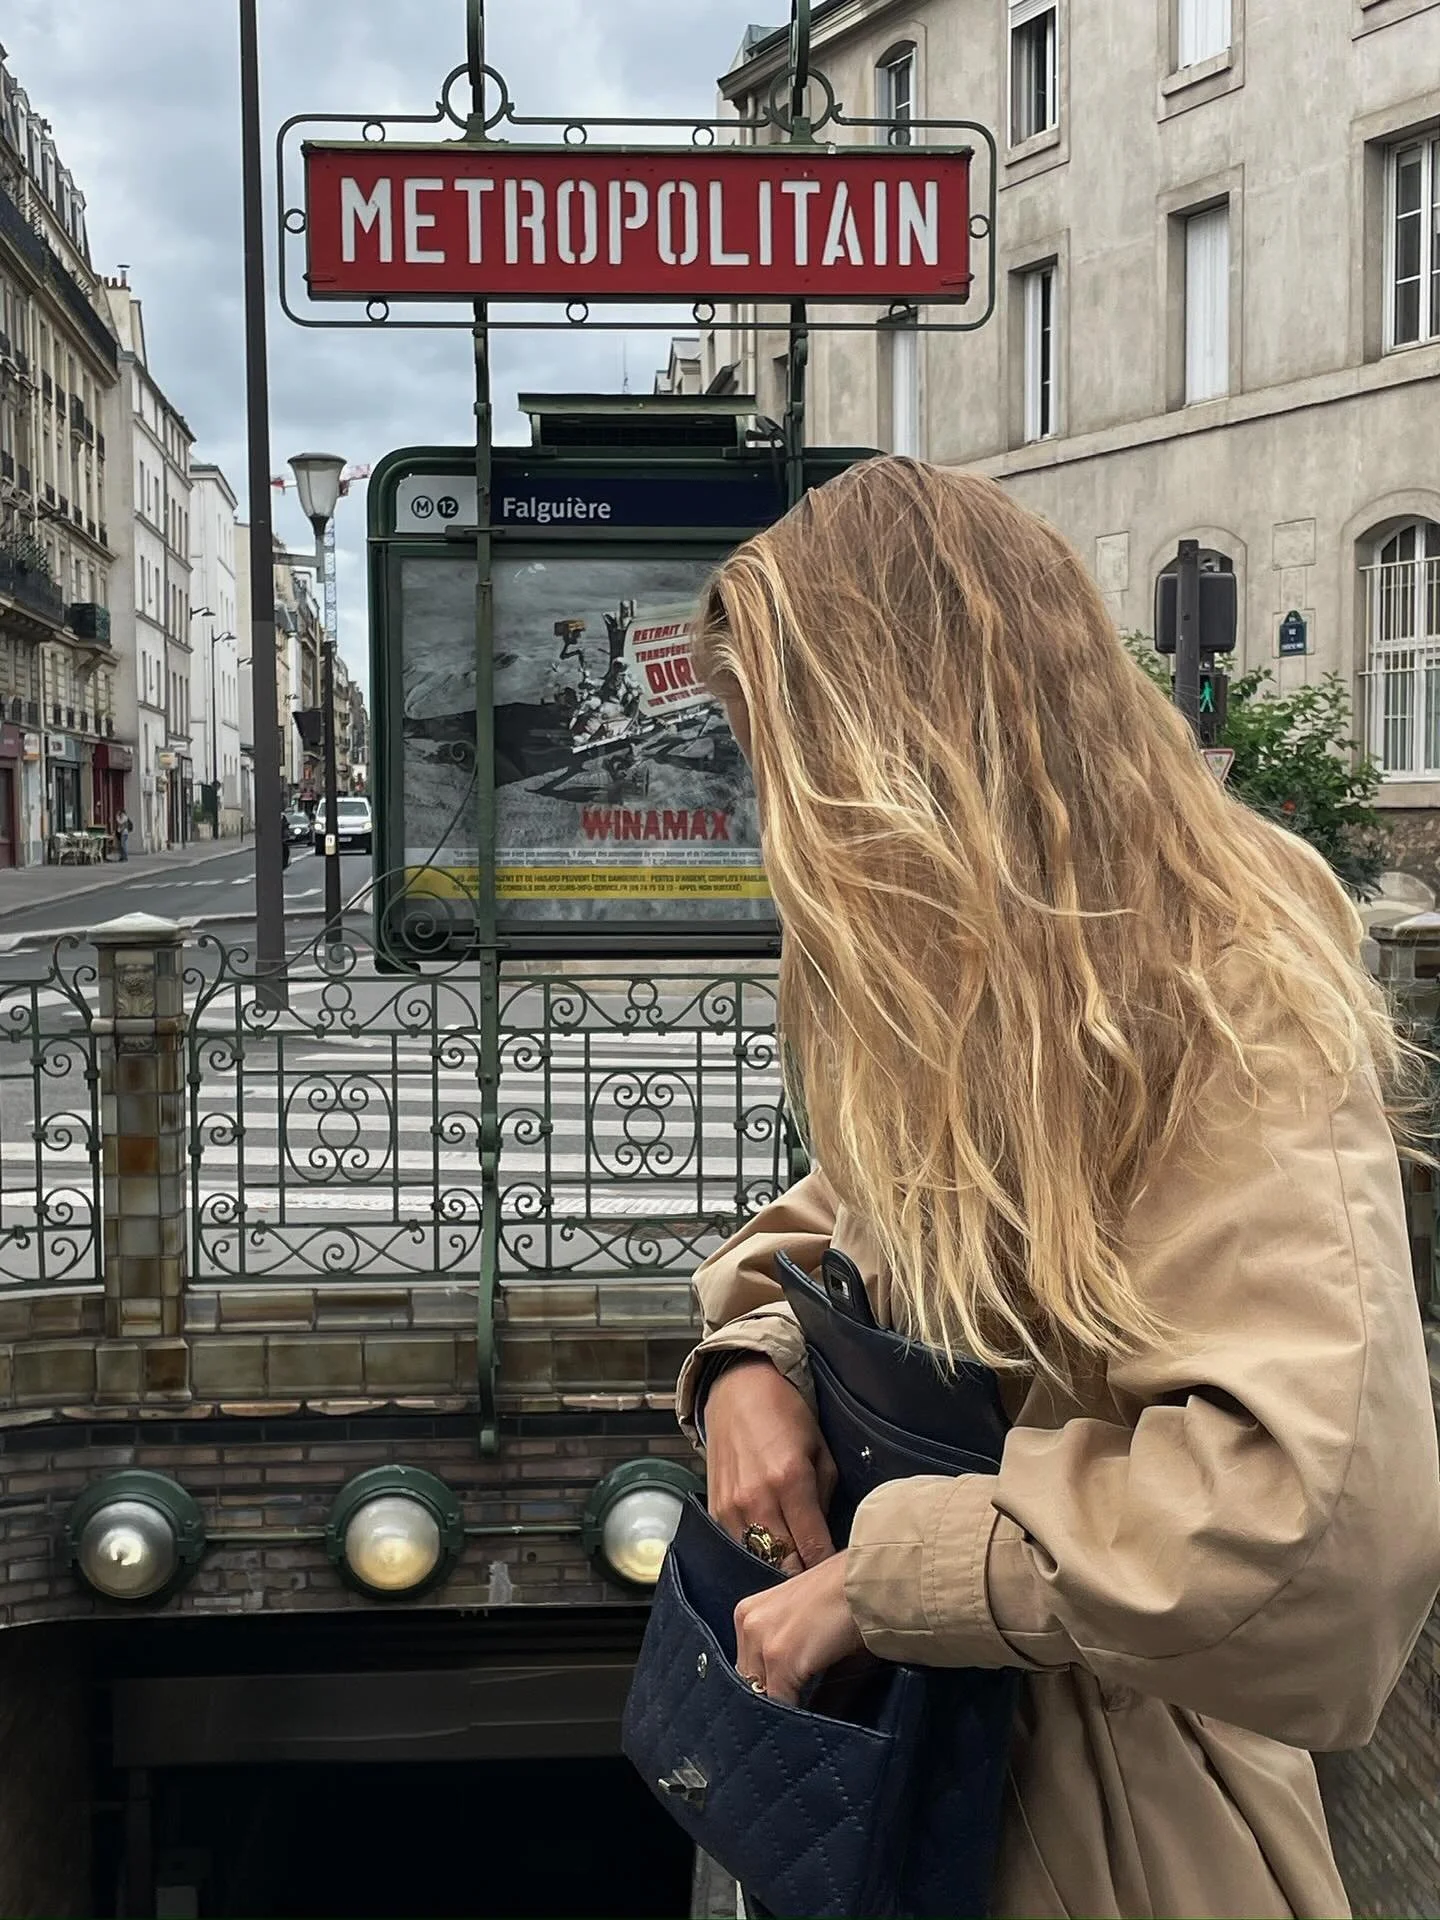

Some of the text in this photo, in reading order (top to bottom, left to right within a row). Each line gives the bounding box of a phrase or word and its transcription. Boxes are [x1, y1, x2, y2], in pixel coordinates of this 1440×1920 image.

[340, 177, 938, 266] METROPOLITAIN
[440, 500, 456, 514] 12
[503, 497, 611, 523] Falguière
[633, 624, 681, 643] RETRAIT
[635, 642, 690, 663] TRANSFÉRE
[645, 657, 696, 694] DIR
[582, 806, 730, 841] WINAMAX
